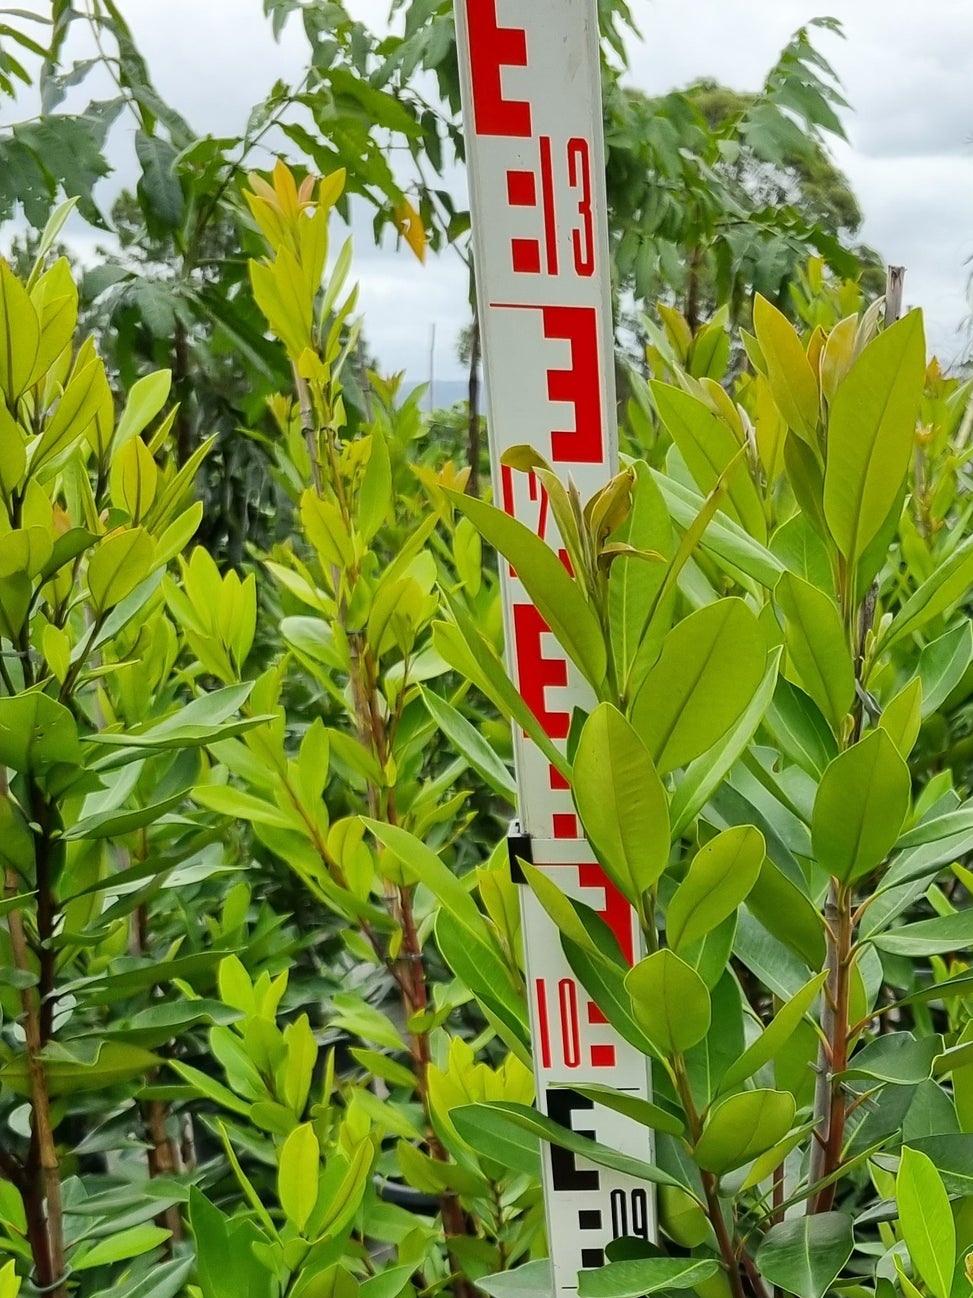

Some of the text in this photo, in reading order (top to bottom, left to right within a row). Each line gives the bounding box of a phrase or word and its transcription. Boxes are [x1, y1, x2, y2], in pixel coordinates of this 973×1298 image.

[538, 136, 595, 277] 13
[535, 978, 581, 1069] 10
[610, 1188, 649, 1241] 09
